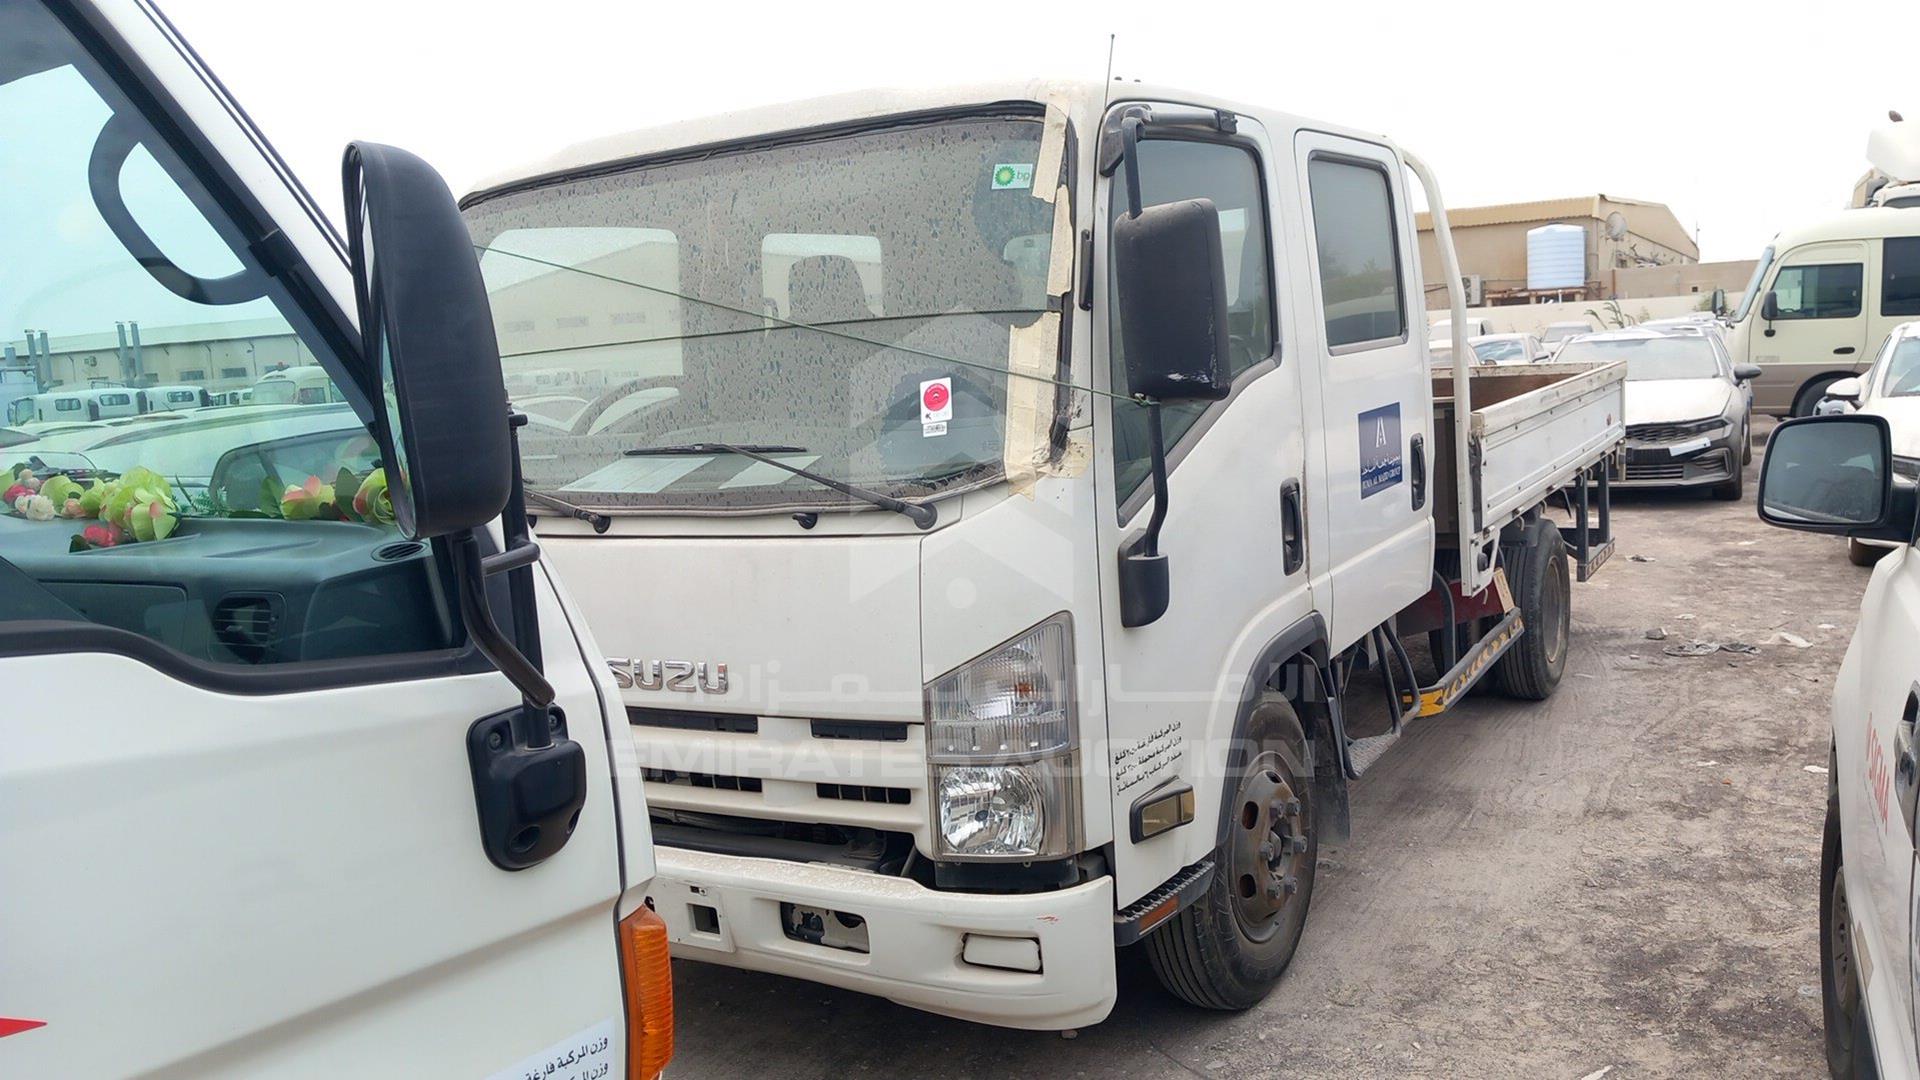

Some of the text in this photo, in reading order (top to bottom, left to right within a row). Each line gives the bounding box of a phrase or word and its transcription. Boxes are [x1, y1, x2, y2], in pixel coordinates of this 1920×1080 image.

[1017, 170, 1030, 182] bp
[600, 656, 728, 694] SUZU
[590, 1037, 608, 1055] وزن
[558, 1045, 588, 1070] المركبة
